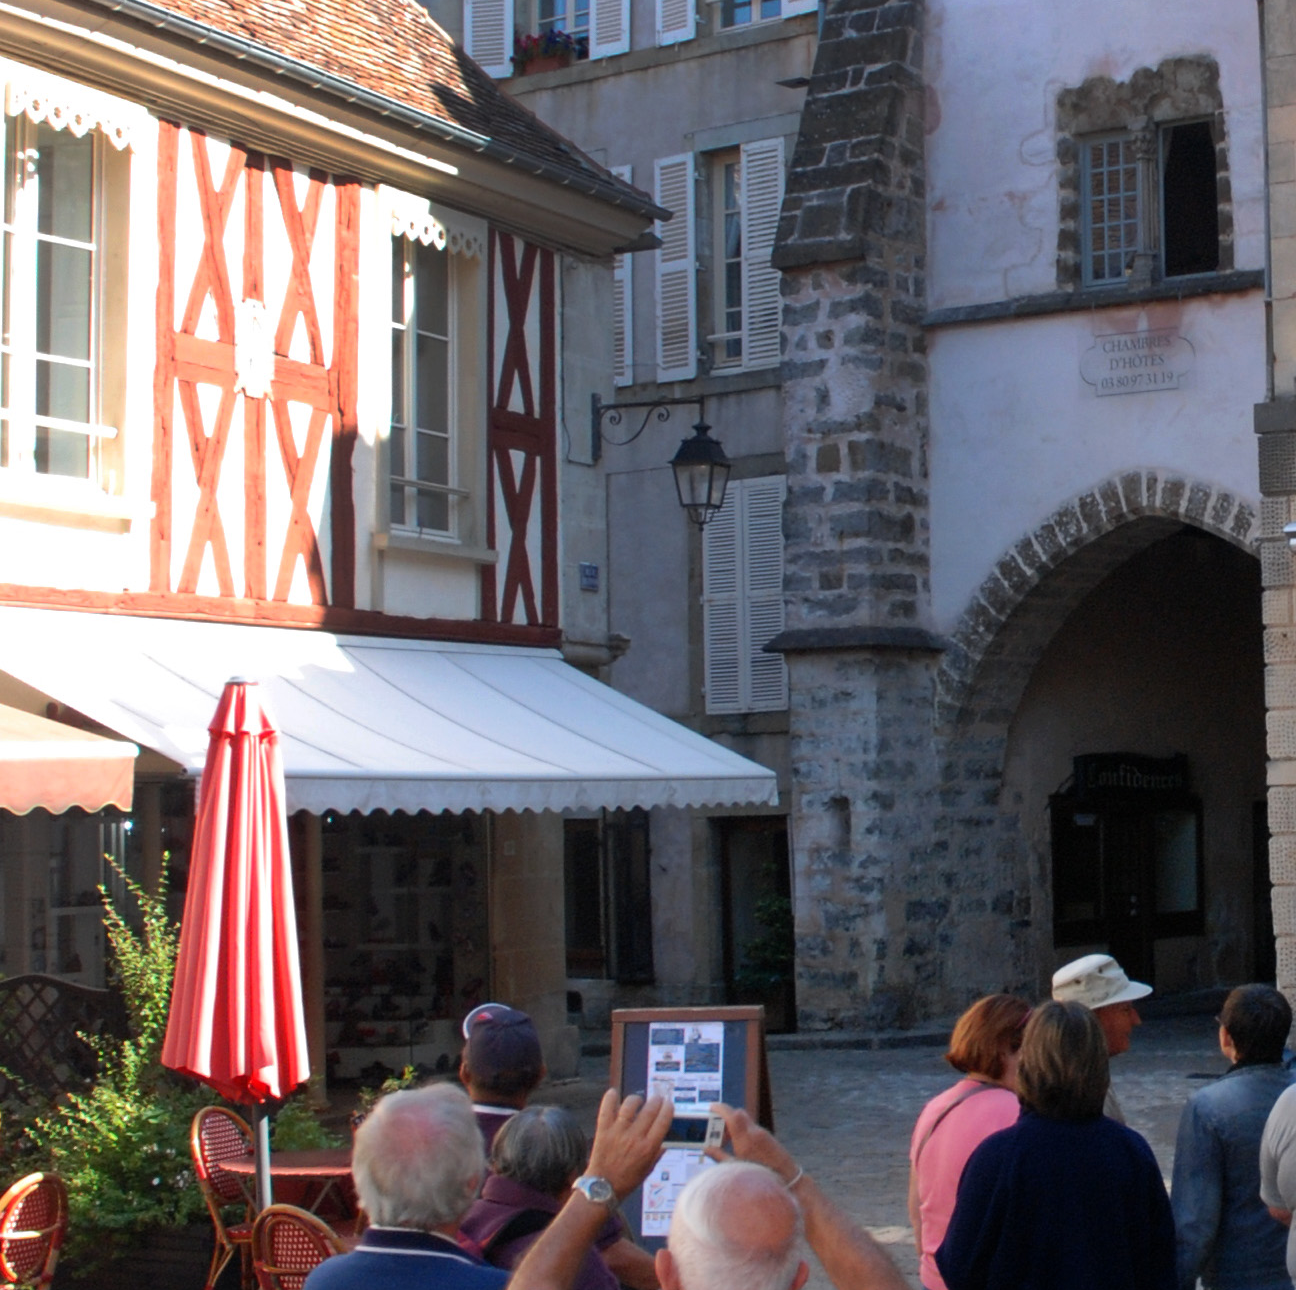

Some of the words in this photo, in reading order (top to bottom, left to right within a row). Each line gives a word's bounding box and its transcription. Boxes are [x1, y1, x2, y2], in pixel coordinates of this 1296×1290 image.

[1102, 335, 1171, 354] CHAMBRES
[1109, 354, 1165, 370] D'HÔTES
[1101, 377, 1114, 389] 03
